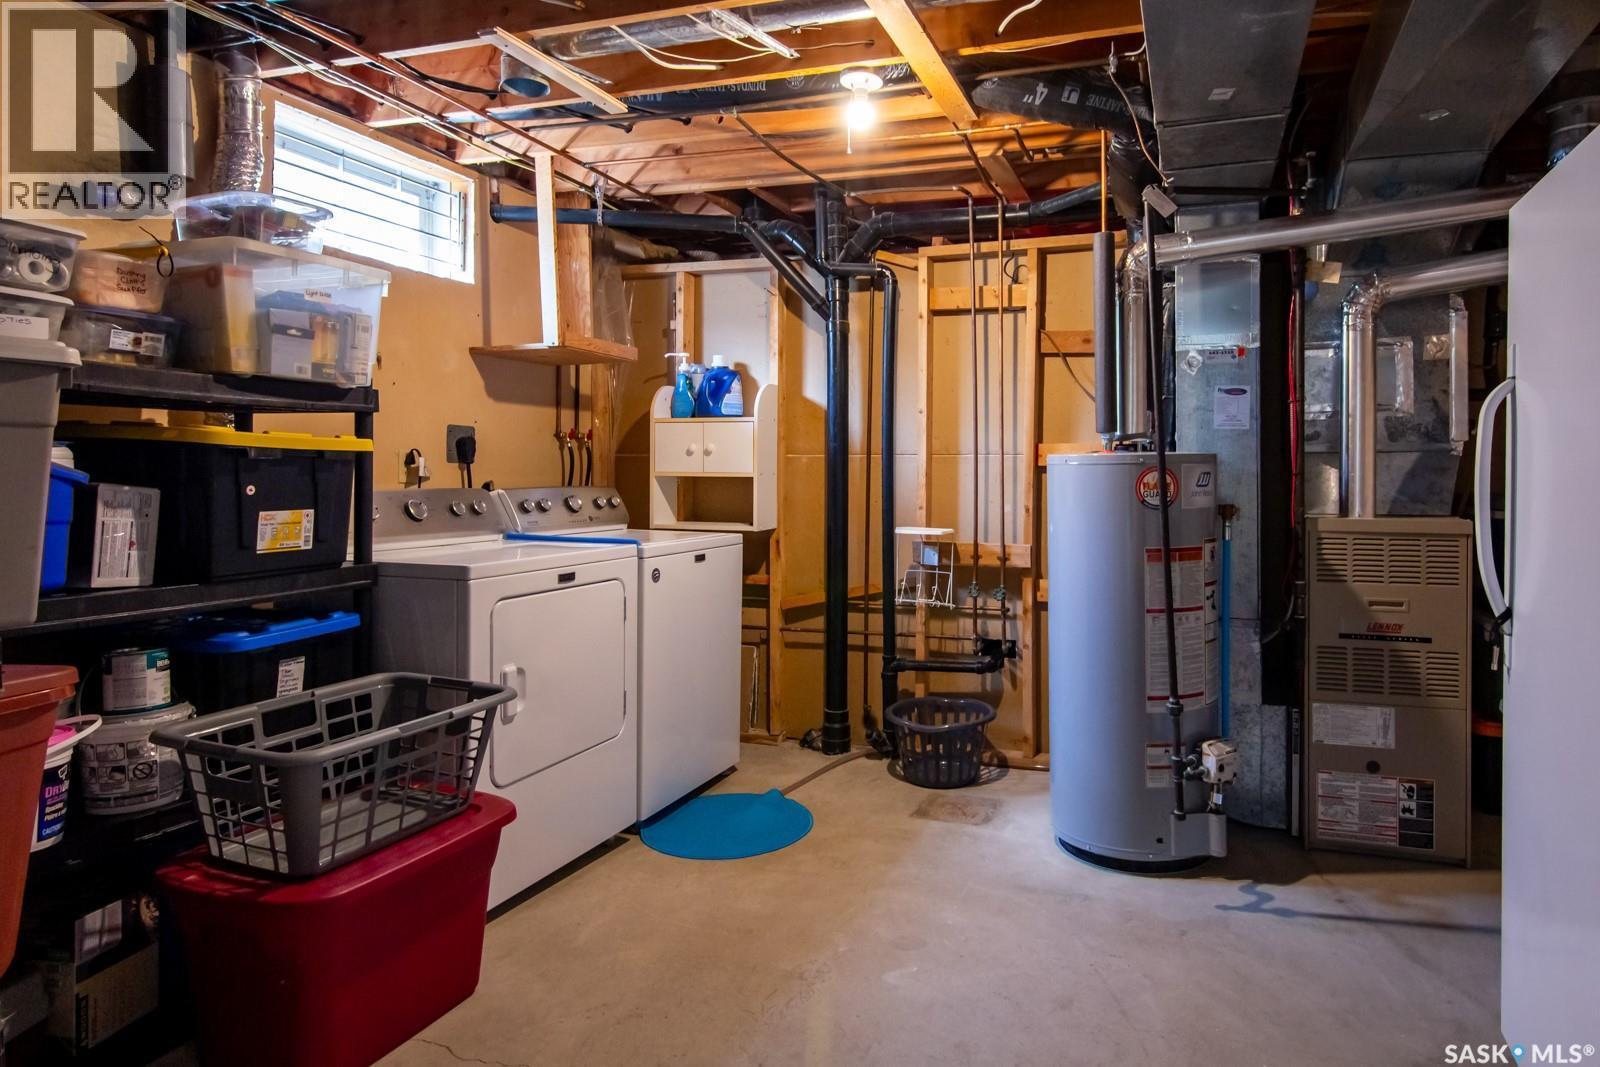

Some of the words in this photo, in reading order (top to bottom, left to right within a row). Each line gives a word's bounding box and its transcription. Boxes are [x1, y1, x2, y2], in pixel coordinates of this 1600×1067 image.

[1143, 481, 1172, 490] FLAE
[1143, 490, 1172, 498] GUAD
[1366, 621, 1405, 633] LENNOX
